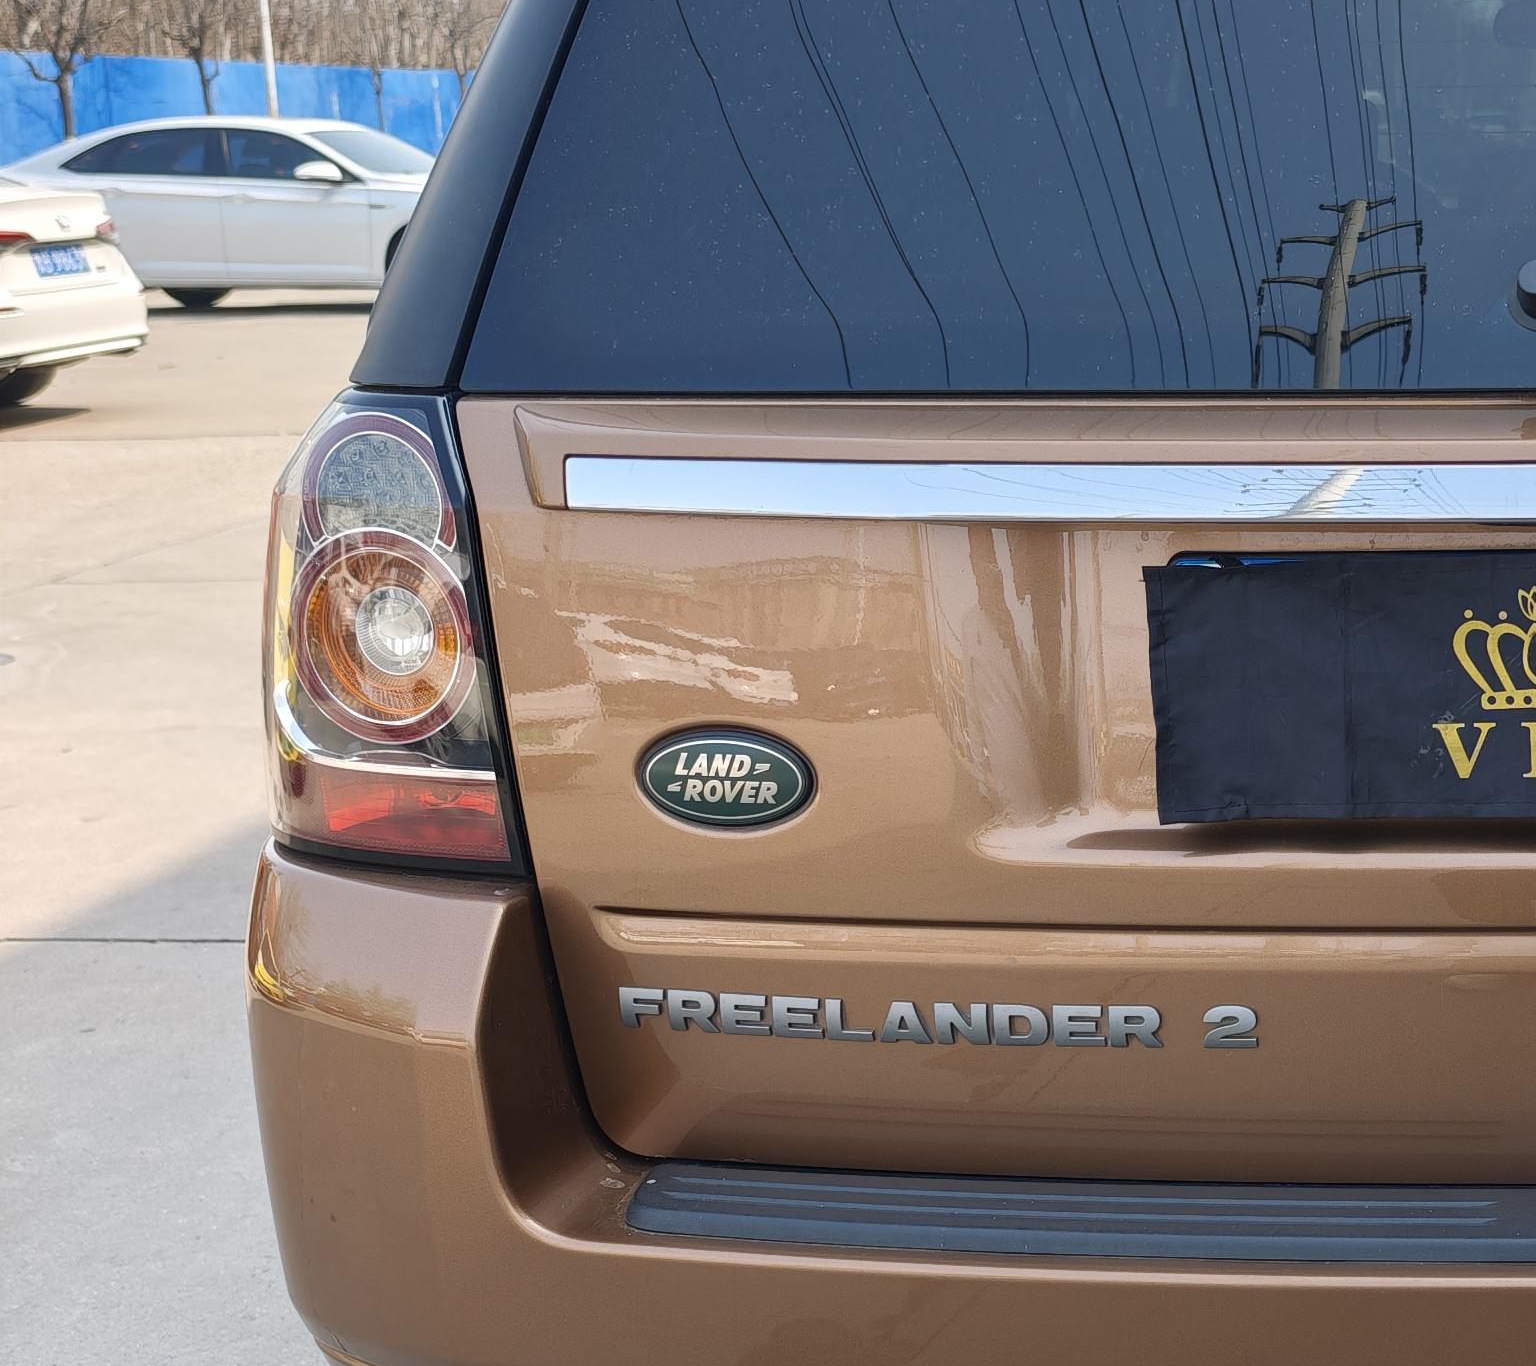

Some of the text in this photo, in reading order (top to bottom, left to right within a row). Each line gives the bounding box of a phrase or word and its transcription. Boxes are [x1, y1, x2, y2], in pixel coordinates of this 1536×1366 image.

[674, 752, 752, 778] LAND
[683, 779, 779, 804] ROVER
[618, 986, 1259, 1048] FREELANDER 2
